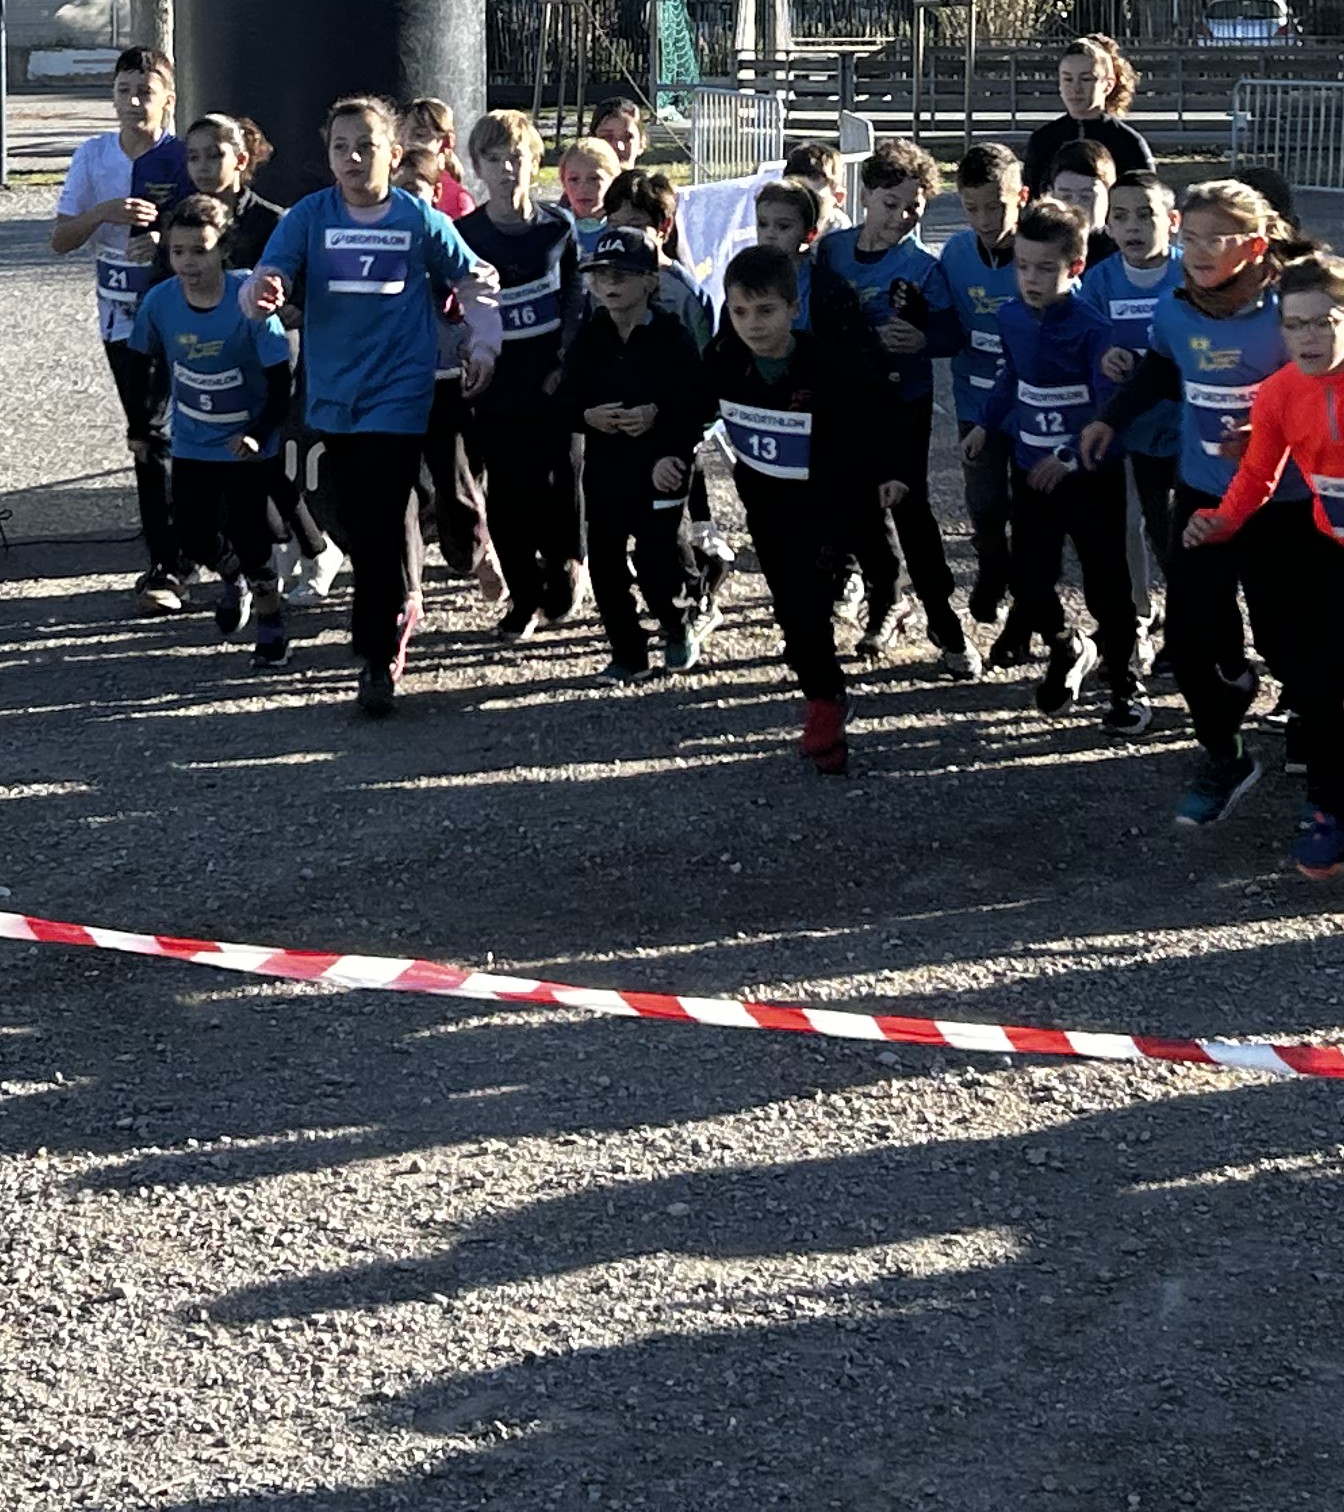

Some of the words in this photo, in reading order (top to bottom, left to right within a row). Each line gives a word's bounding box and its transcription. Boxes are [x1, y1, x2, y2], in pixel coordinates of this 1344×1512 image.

[359, 255, 375, 277] 7
[108, 269, 128, 288] 21
[509, 306, 537, 327] 16
[200, 393, 213, 410] 5
[1035, 411, 1066, 432] 12
[748, 433, 777, 460] 13
